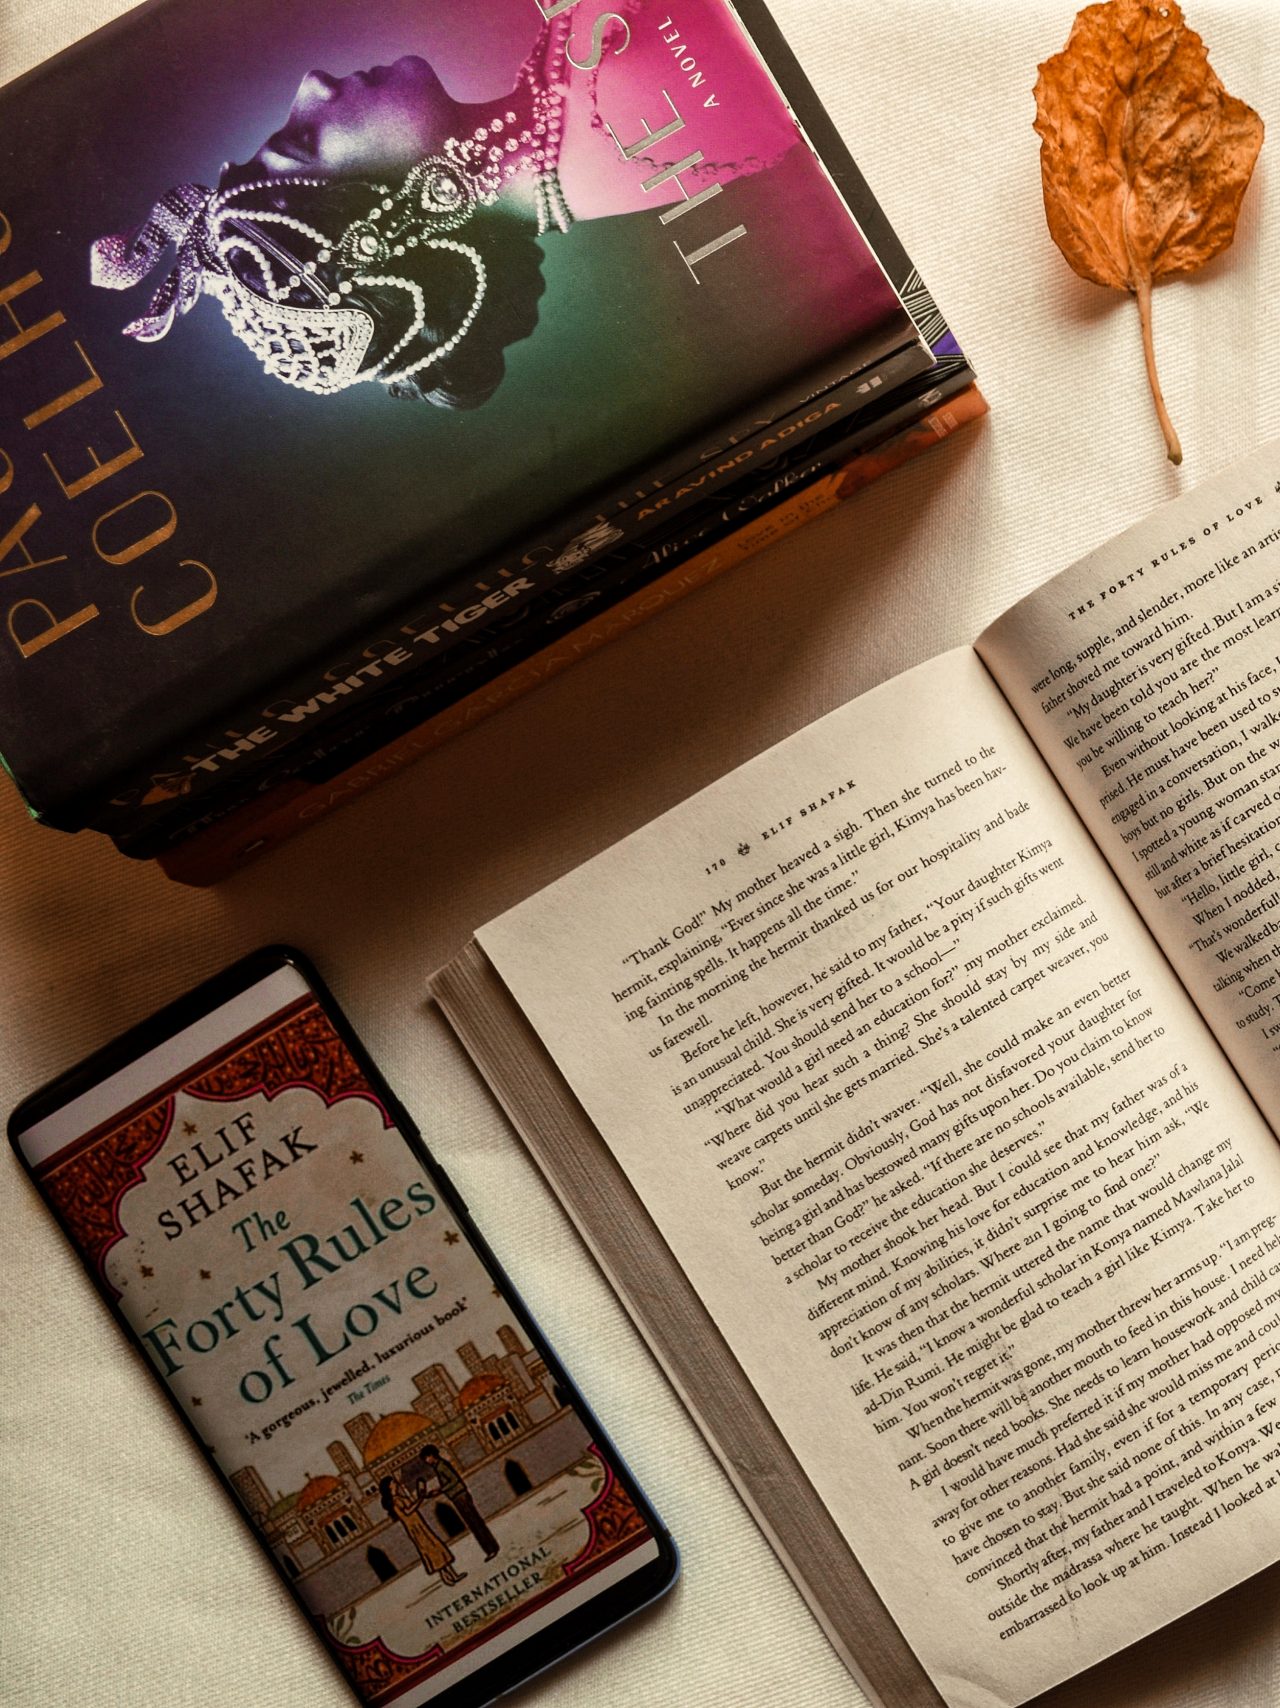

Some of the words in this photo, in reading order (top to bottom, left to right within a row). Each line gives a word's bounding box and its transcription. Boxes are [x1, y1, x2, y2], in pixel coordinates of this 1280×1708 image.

[657, 15, 706, 89] NOVEL
[703, 94, 720, 109] A
[606, 90, 747, 285] THE
[0, 210, 218, 636] COELH
[638, 449, 754, 521] ARAVIND
[760, 402, 843, 450] ADIGA
[1030, 676, 1052, 694] were
[1047, 660, 1078, 681] long,
[1076, 635, 1116, 663] supple,
[1115, 615, 1138, 638] and
[1137, 591, 1185, 623] slender,
[1183, 570, 1216, 595] more
[1214, 555, 1240, 575] like
[1241, 545, 1258, 560] an
[1067, 599, 1095, 621] THE
[1099, 567, 1144, 601] FORTY
[1150, 536, 1196, 568] RULES
[1202, 521, 1219, 536] OF
[1225, 496, 1263, 523] LOVE
[190, 725, 279, 776] THE
[277, 646, 414, 723] WHITE
[412, 577, 536, 644] TIGER
[705, 858, 726, 876] 170
[760, 816, 793, 841] ELIF
[799, 779, 857, 818] SHAFAK
[710, 898, 733, 917] My
[735, 871, 778, 903] mother
[776, 842, 822, 876] heaved
[823, 840, 832, 849] a
[833, 821, 863, 843] sigh.
[862, 800, 899, 823] Then
[901, 787, 922, 803] she
[923, 760, 963, 790] turned
[964, 756, 978, 767] to
[979, 746, 996, 760] the
[1217, 864, 1247, 886] little
[1248, 847, 1274, 872] girl,
[756, 1065, 795, 1095] would
[794, 1064, 804, 1074] a
[803, 1047, 826, 1071] girl
[825, 1028, 856, 1055] need
[855, 1023, 872, 1037] an
[873, 987, 931, 1026] education
[963, 954, 984, 977] my
[985, 928, 1029, 959] mother
[1031, 894, 1087, 932] exclaimed.
[158, 1127, 317, 1240] SHAFAK
[166, 1111, 256, 1187] ELIF
[142, 1273, 285, 1379] Forty
[278, 1182, 436, 1291] Rules
[231, 1210, 291, 1253] The
[817, 1295, 889, 1341] appreciation
[888, 1281, 903, 1299] of
[902, 1274, 922, 1291] my
[923, 1247, 974, 1279] abilities,
[972, 1238, 988, 1250] it
[1023, 1188, 1069, 1221] surprise
[1070, 1175, 1091, 1192] me
[1092, 1166, 1107, 1178] to
[1106, 1147, 1135, 1169] hear
[1134, 1132, 1162, 1151] him
[1163, 1117, 1186, 1135] ask,
[239, 1334, 296, 1404] of
[290, 1266, 438, 1367] Love
[373, 1323, 435, 1364] luxurious
[424, 1546, 552, 1630] INTERNATIONAL
[452, 1572, 544, 1634] BESTSELLER
[999, 1593, 1069, 1641] embarrassed
[1065, 1588, 1082, 1602] to
[1080, 1572, 1111, 1595] look
[1110, 1564, 1127, 1578] up
[1128, 1556, 1141, 1569] at
[1138, 1542, 1170, 1562] him.
[1169, 1511, 1215, 1545] Instead
[1212, 1506, 1222, 1519] I
[1220, 1481, 1264, 1515] looked
[1264, 1476, 1278, 1489] at
